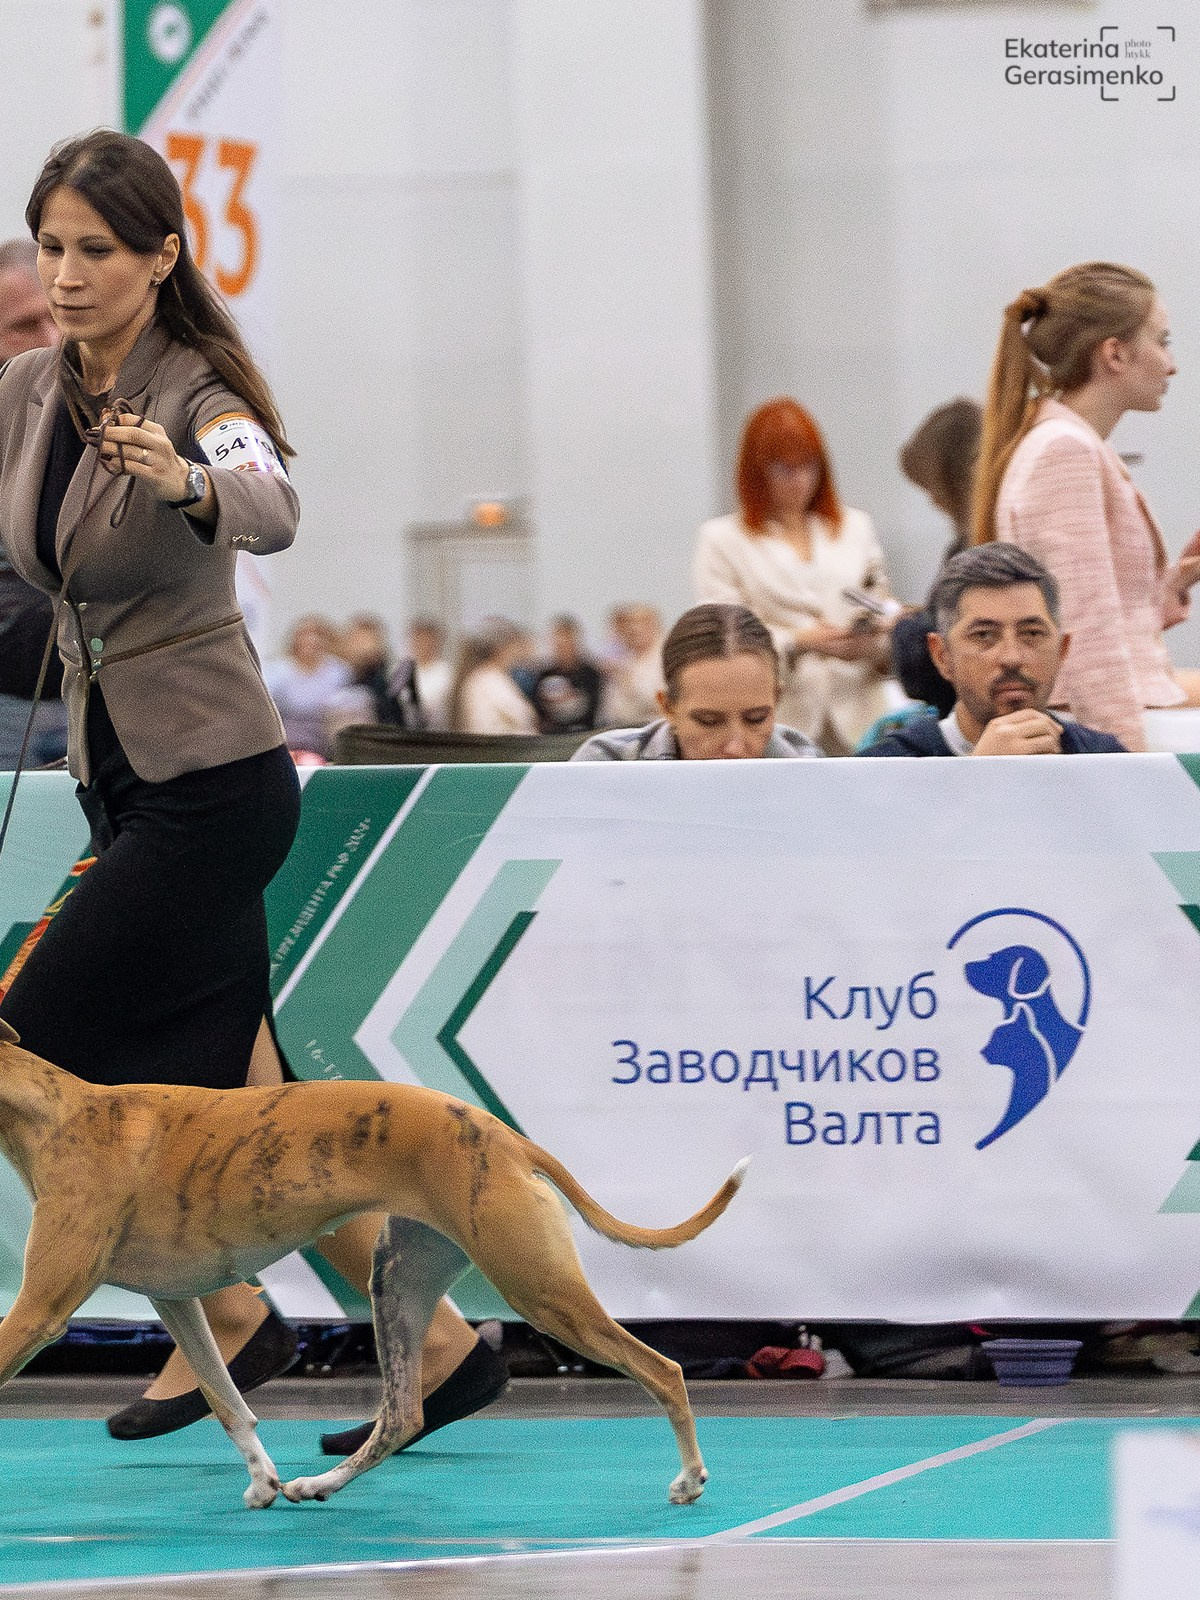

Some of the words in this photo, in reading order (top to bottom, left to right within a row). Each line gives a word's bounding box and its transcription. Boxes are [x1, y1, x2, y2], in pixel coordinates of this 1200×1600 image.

[166, 132, 259, 297] 33
[803, 970, 939, 1031] Клуб
[611, 1038, 942, 1092] Заводчиков
[784, 1100, 942, 1146] Валта
